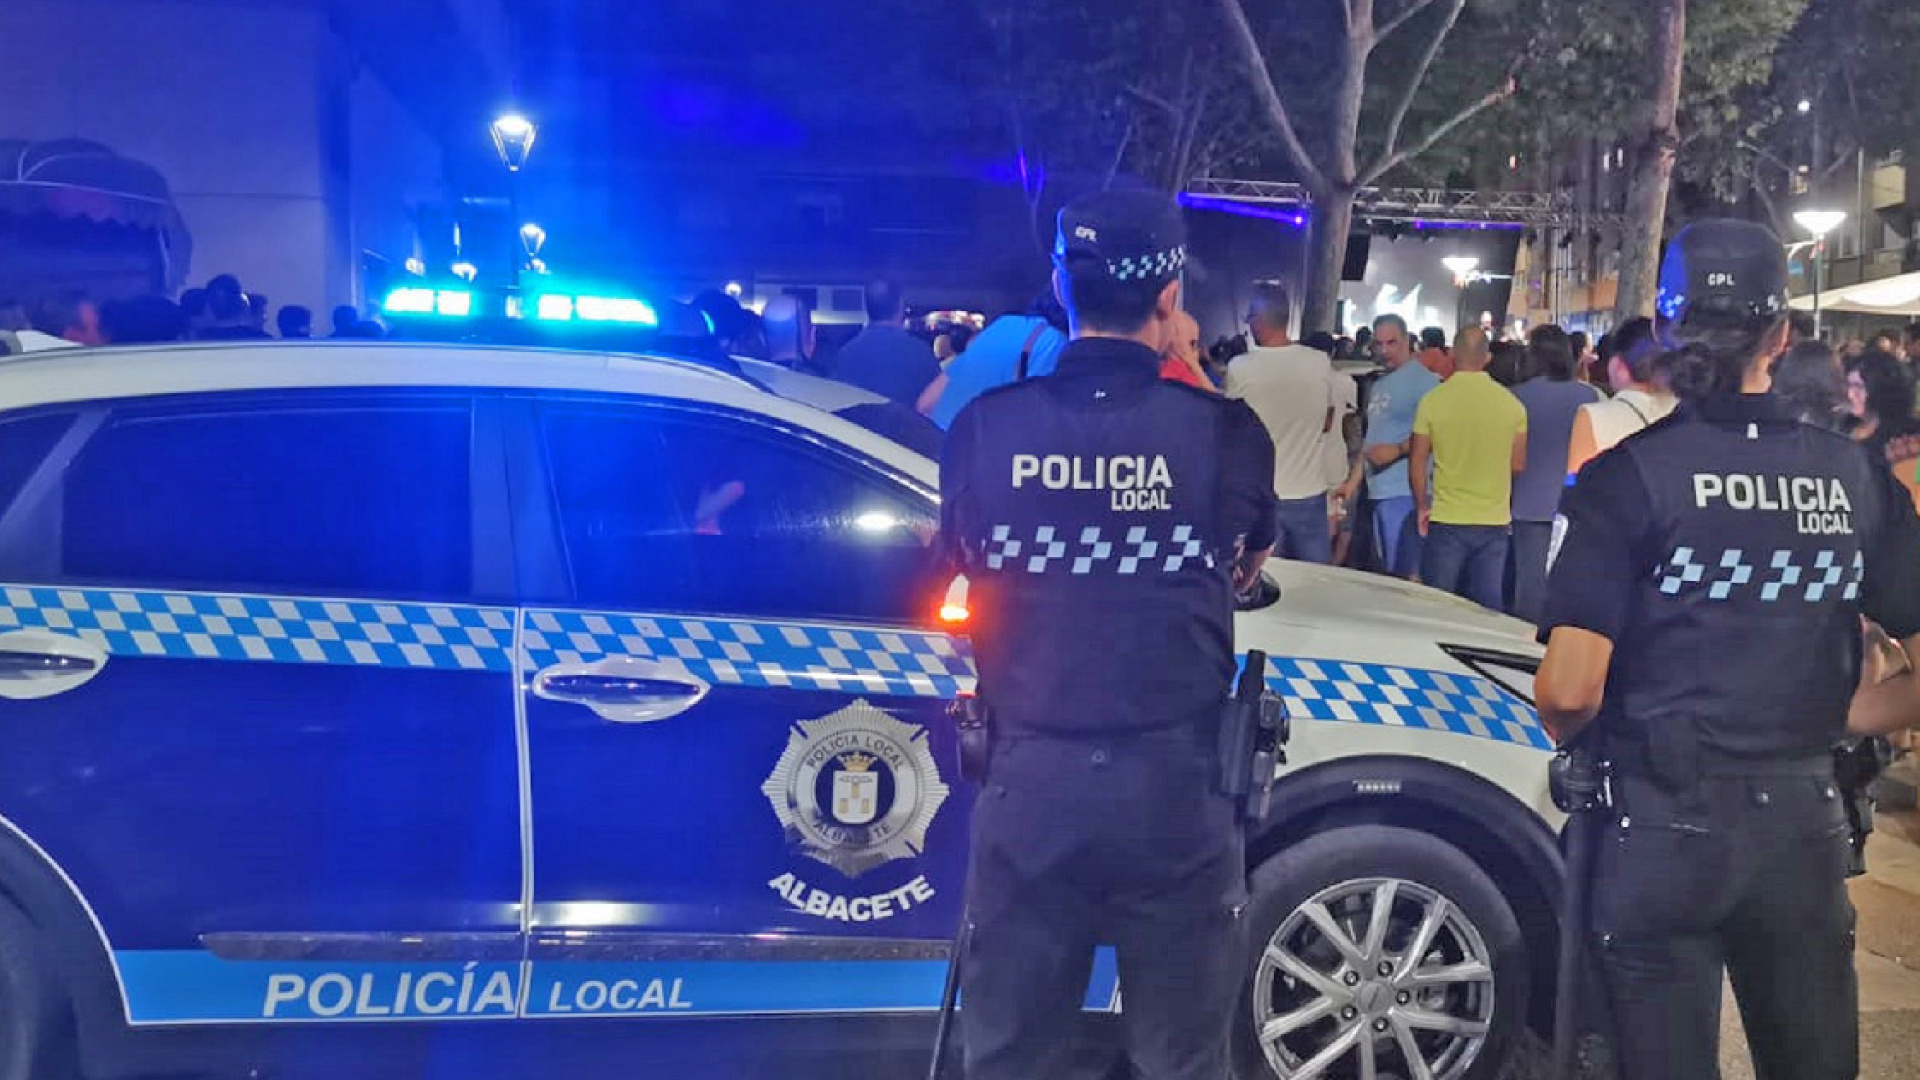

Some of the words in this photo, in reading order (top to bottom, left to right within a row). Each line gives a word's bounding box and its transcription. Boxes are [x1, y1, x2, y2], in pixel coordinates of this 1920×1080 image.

[1707, 272, 1736, 286] CPL
[1012, 454, 1173, 490] POLICIA
[1111, 488, 1172, 512] LOCAL
[1693, 473, 1852, 512] POLICIA
[1797, 510, 1854, 534] LOCAL
[866, 736, 905, 771] LOCAL
[813, 821, 892, 843] ALBATE
[767, 872, 936, 922] ALBACETE
[262, 961, 516, 1018] POLICÍA
[549, 977, 693, 1011] LOCAL
